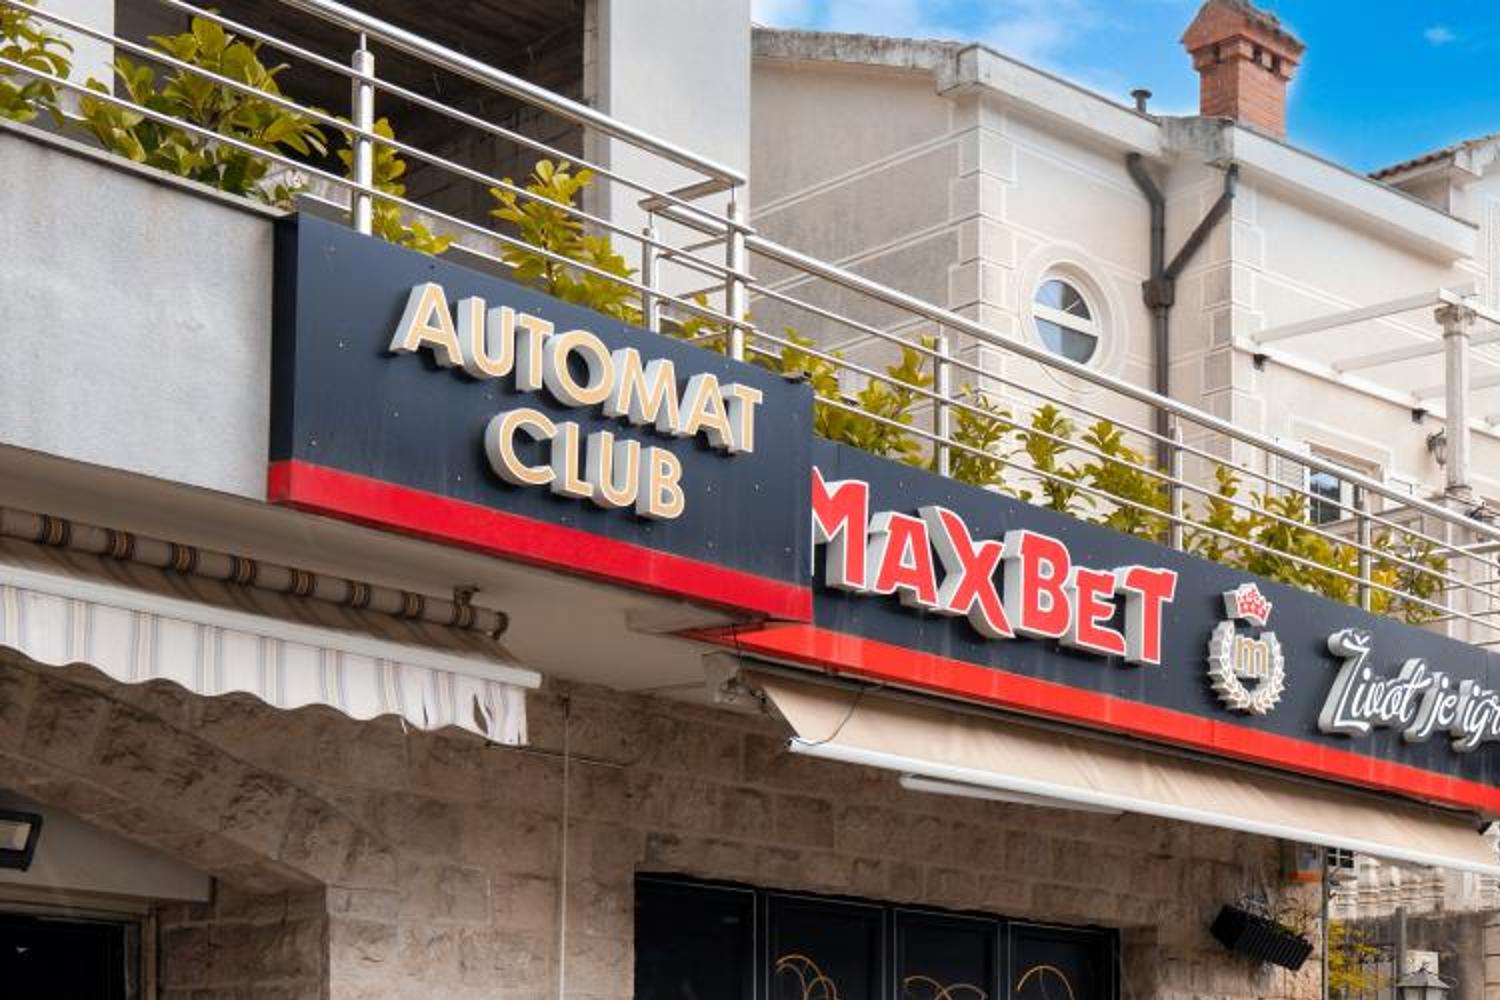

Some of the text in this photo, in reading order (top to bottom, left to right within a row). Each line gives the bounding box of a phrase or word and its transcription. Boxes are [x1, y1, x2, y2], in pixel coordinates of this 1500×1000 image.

[390, 282, 763, 453] AUTOMAT
[484, 408, 686, 519] CLUB
[1328, 633, 1432, 732] Život
[1417, 676, 1456, 737] je
